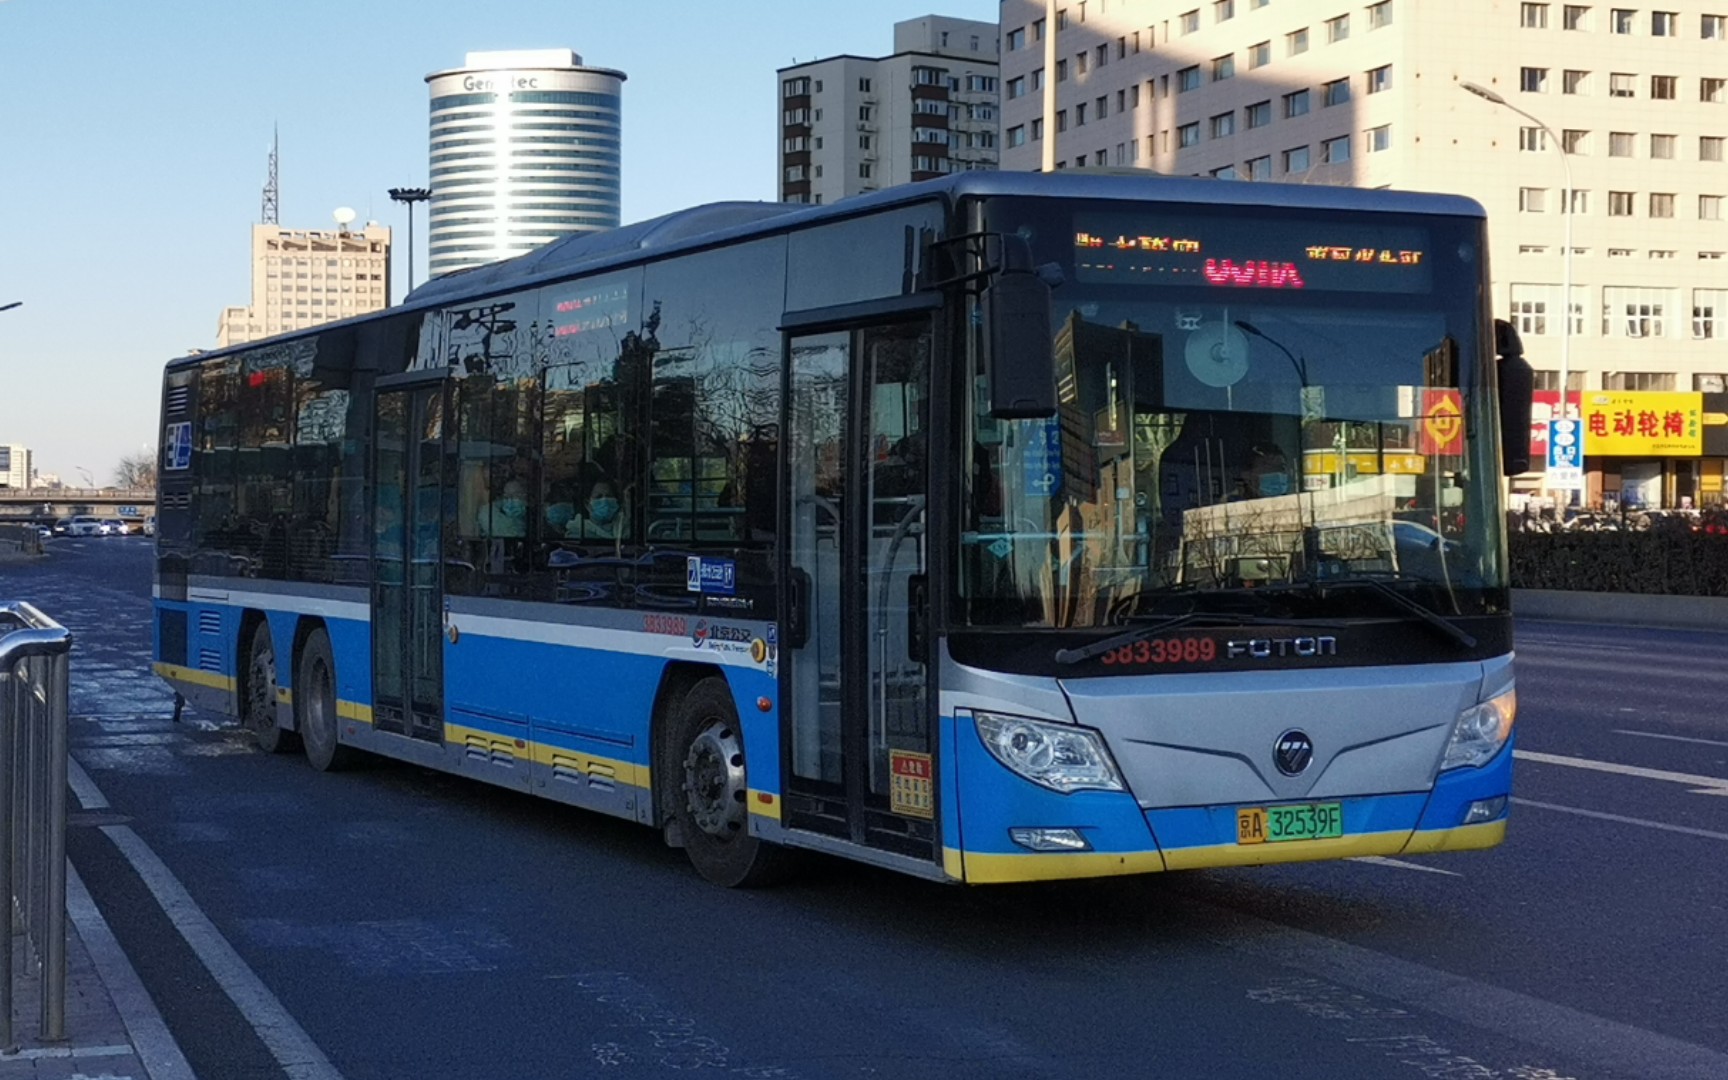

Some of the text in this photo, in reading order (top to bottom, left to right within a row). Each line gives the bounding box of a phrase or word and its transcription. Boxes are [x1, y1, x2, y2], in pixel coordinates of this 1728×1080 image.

[1588, 409, 1684, 438] 电动轮椅
[1227, 635, 1336, 659] FOTON
